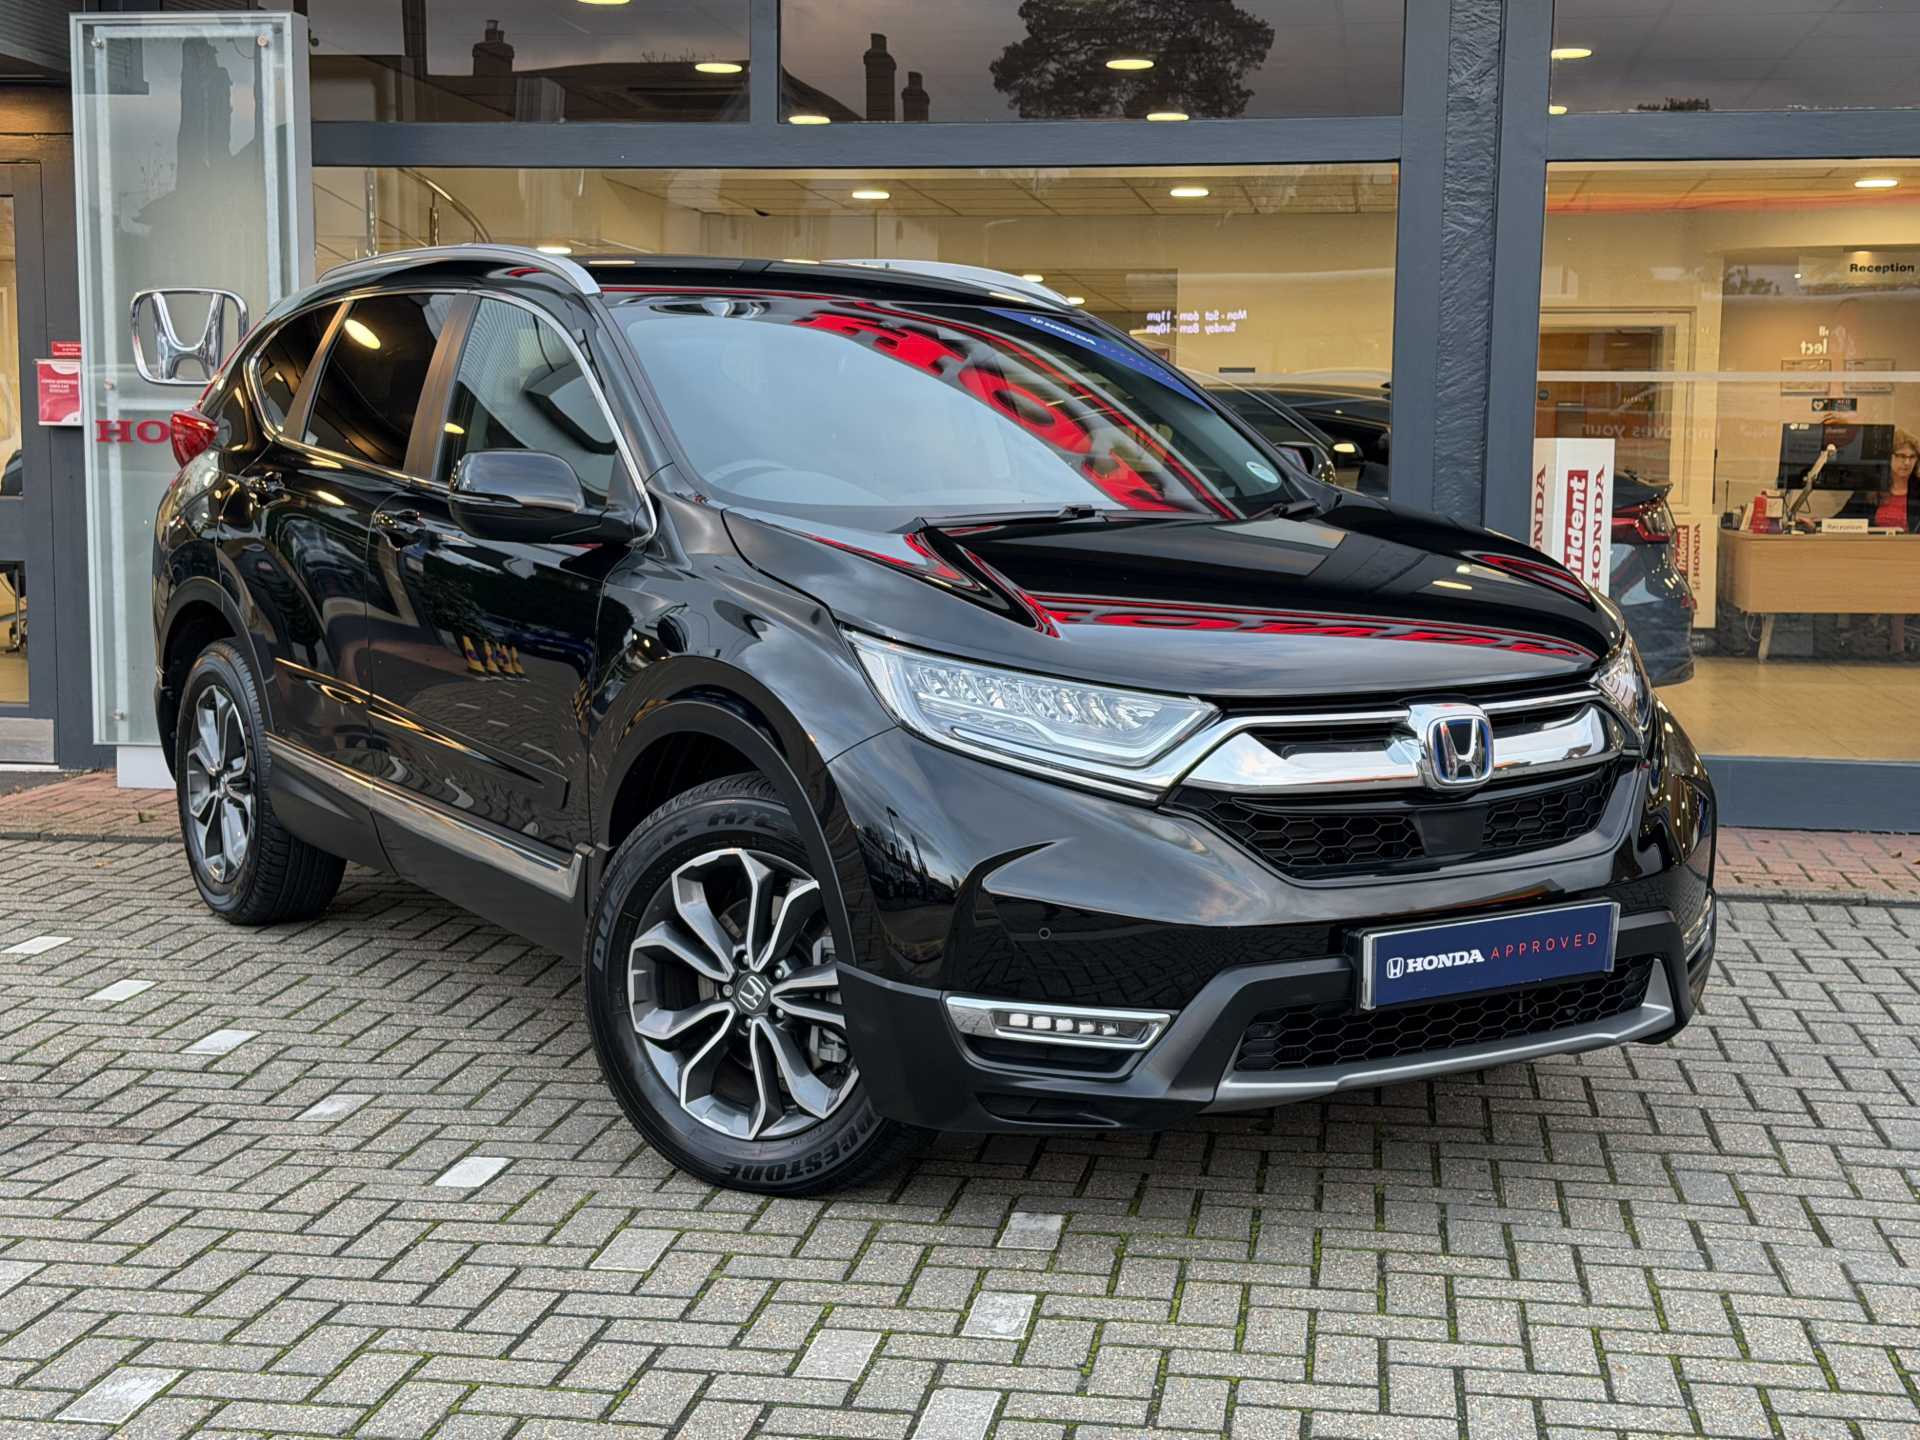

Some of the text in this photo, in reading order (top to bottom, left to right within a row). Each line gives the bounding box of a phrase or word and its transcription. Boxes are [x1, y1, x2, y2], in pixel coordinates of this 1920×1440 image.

[1849, 262, 1915, 275] Reception
[1534, 464, 1546, 551] NDA
[1591, 464, 1606, 593] HONDA
[1406, 932, 1598, 974] HONDA APPROVED
